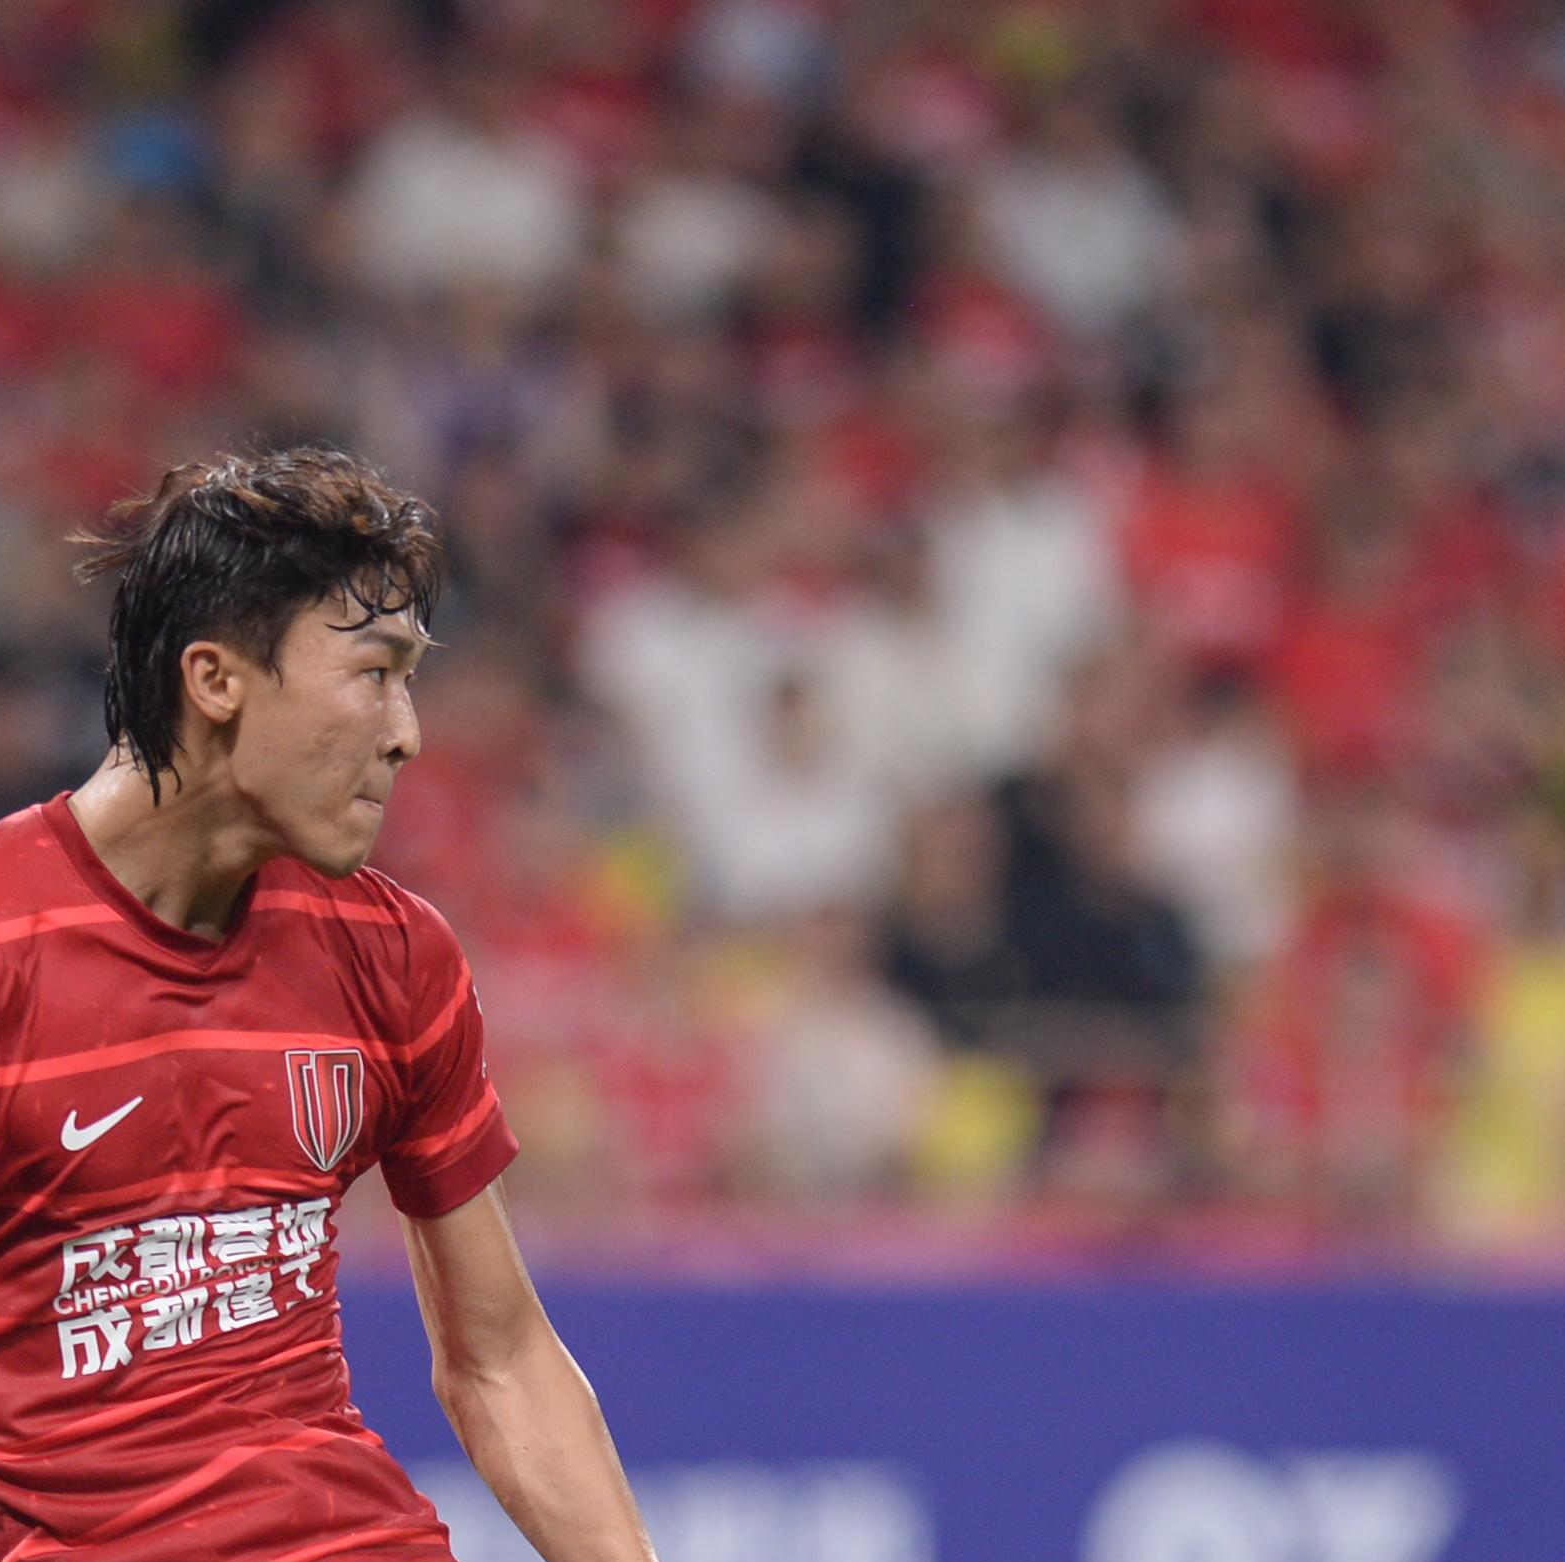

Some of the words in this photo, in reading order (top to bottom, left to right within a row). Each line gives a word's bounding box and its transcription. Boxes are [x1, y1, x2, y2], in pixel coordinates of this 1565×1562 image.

[52, 1270, 192, 1316] CHENGDU
[57, 1251, 323, 1380] 成都建工
